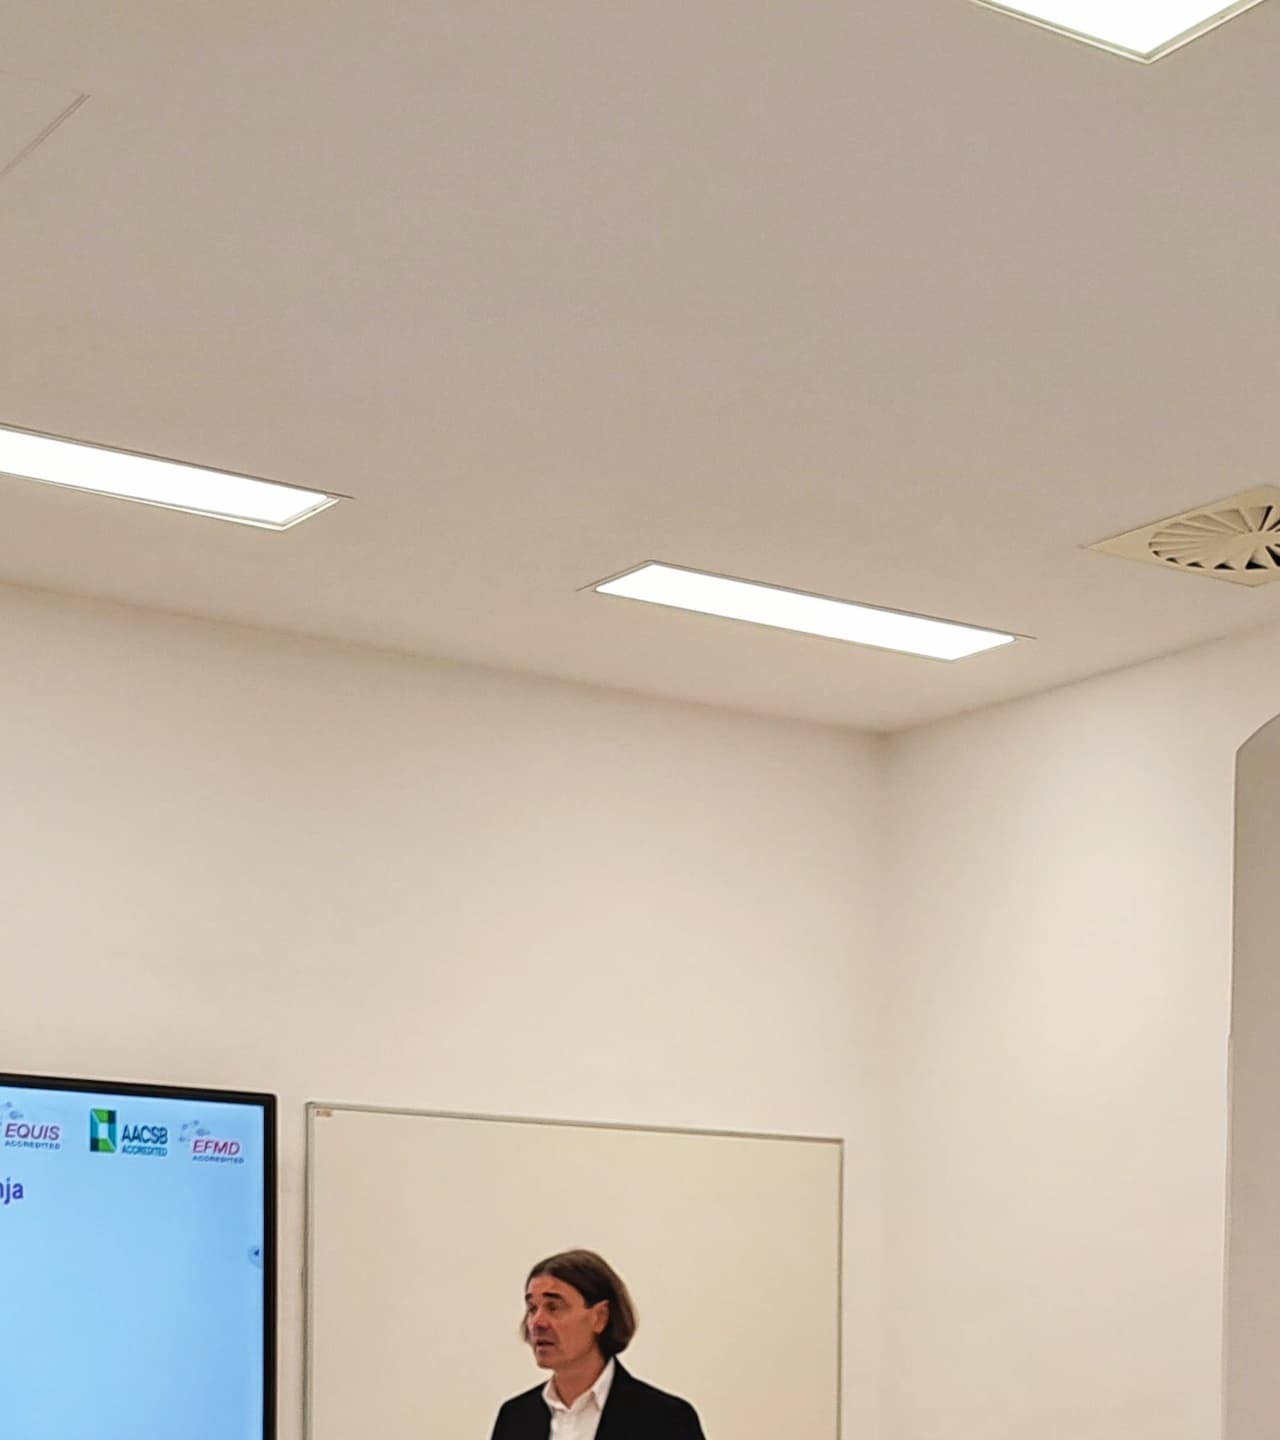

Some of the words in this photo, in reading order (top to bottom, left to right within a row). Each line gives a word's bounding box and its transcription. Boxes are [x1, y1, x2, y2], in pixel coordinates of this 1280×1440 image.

[5, 1123, 60, 1141] EQUIS
[122, 1125, 168, 1145] AACSB
[4, 1140, 60, 1150] ACCREDITED
[122, 1145, 168, 1157] ACCREDITED
[192, 1139, 240, 1156] EFMD
